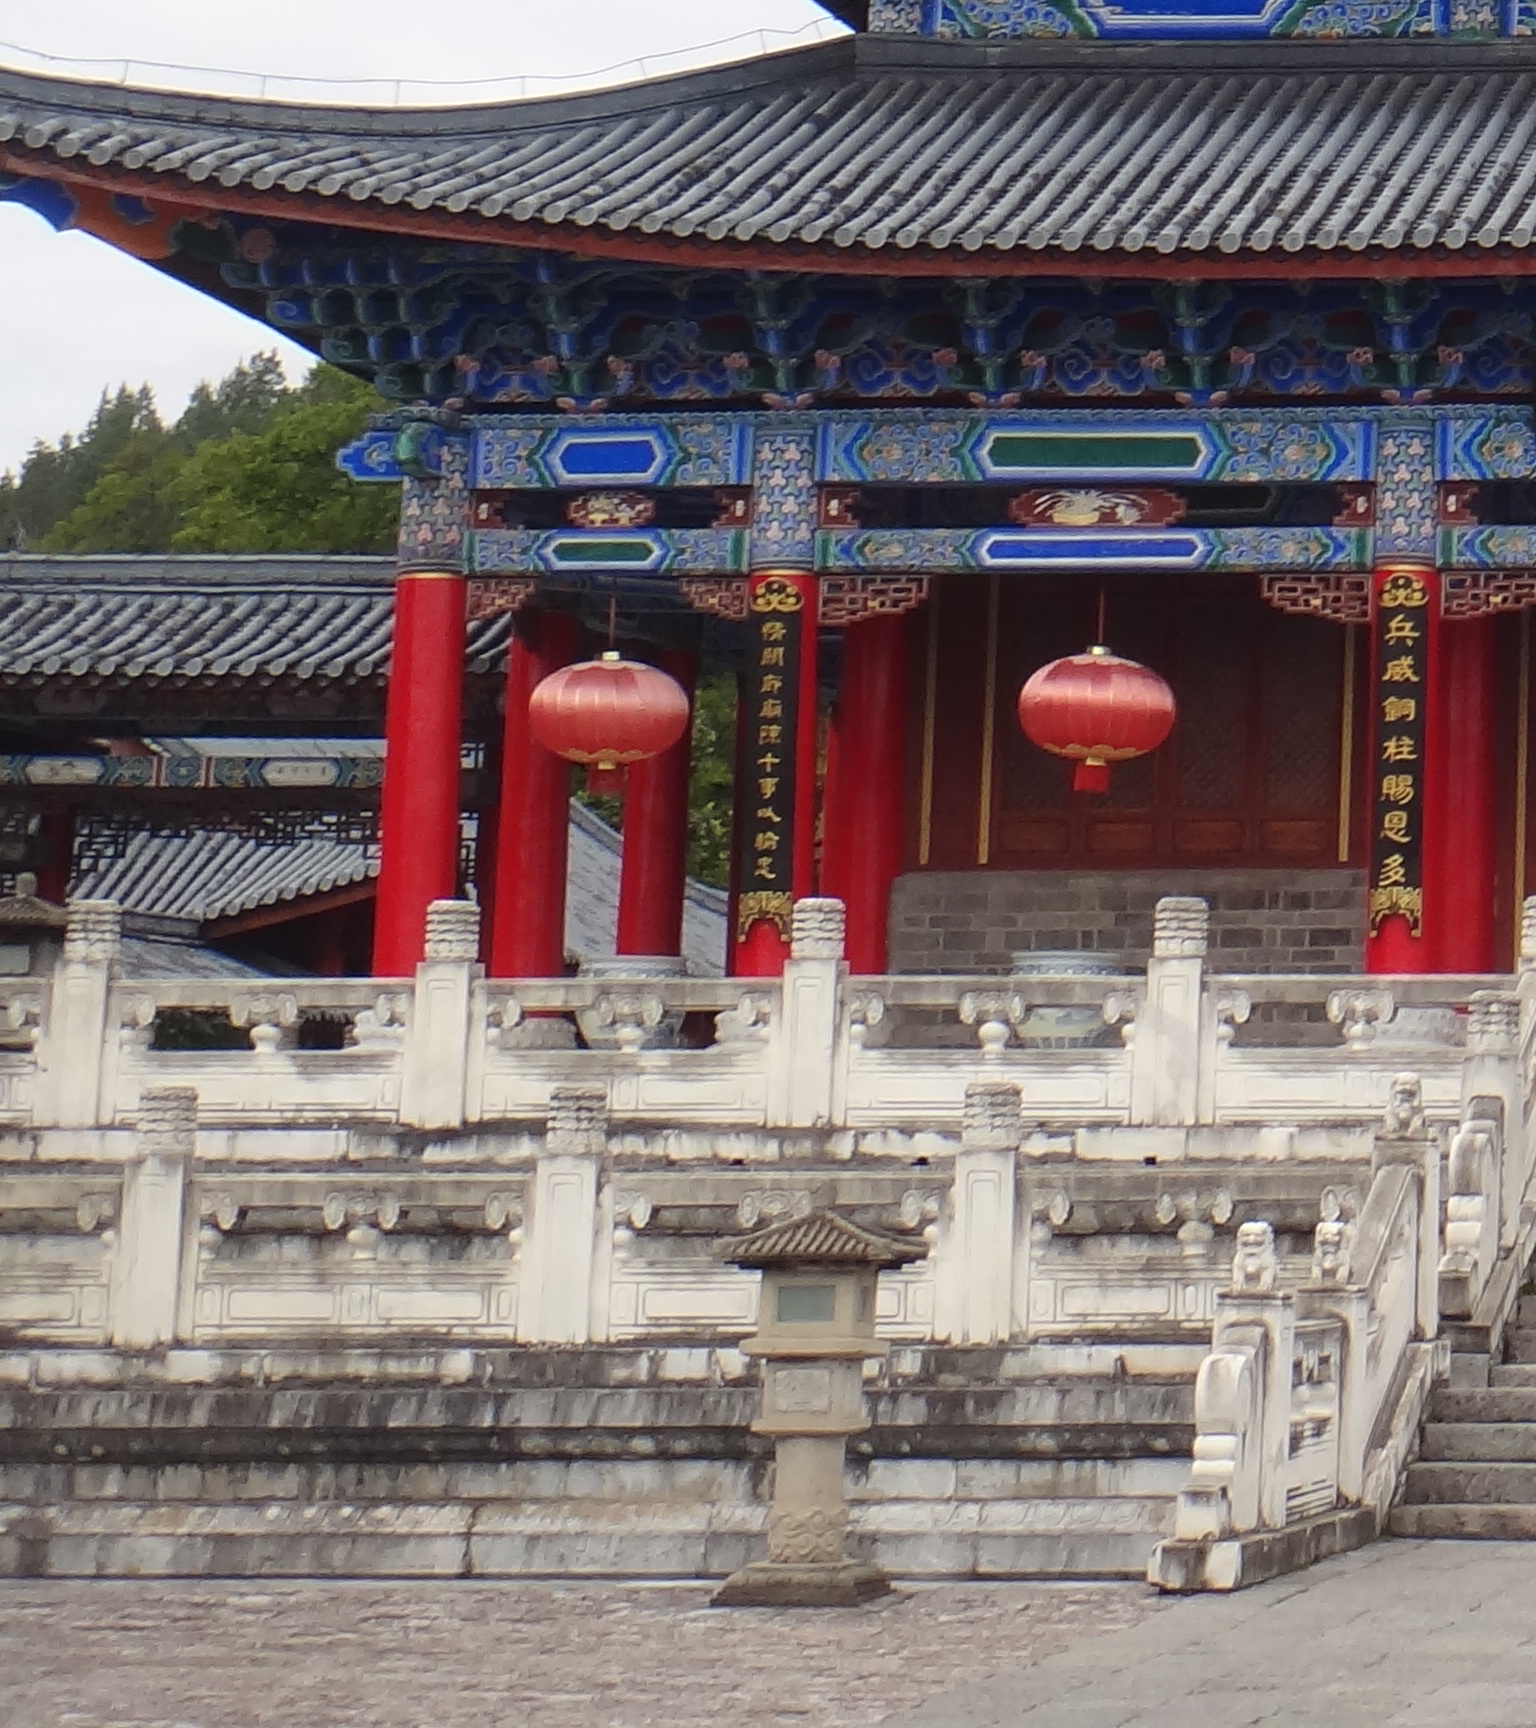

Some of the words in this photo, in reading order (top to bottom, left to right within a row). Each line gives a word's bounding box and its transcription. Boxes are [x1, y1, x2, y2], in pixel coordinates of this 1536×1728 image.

[1379, 613, 1421, 887] 兵威銅柱賜恩多
